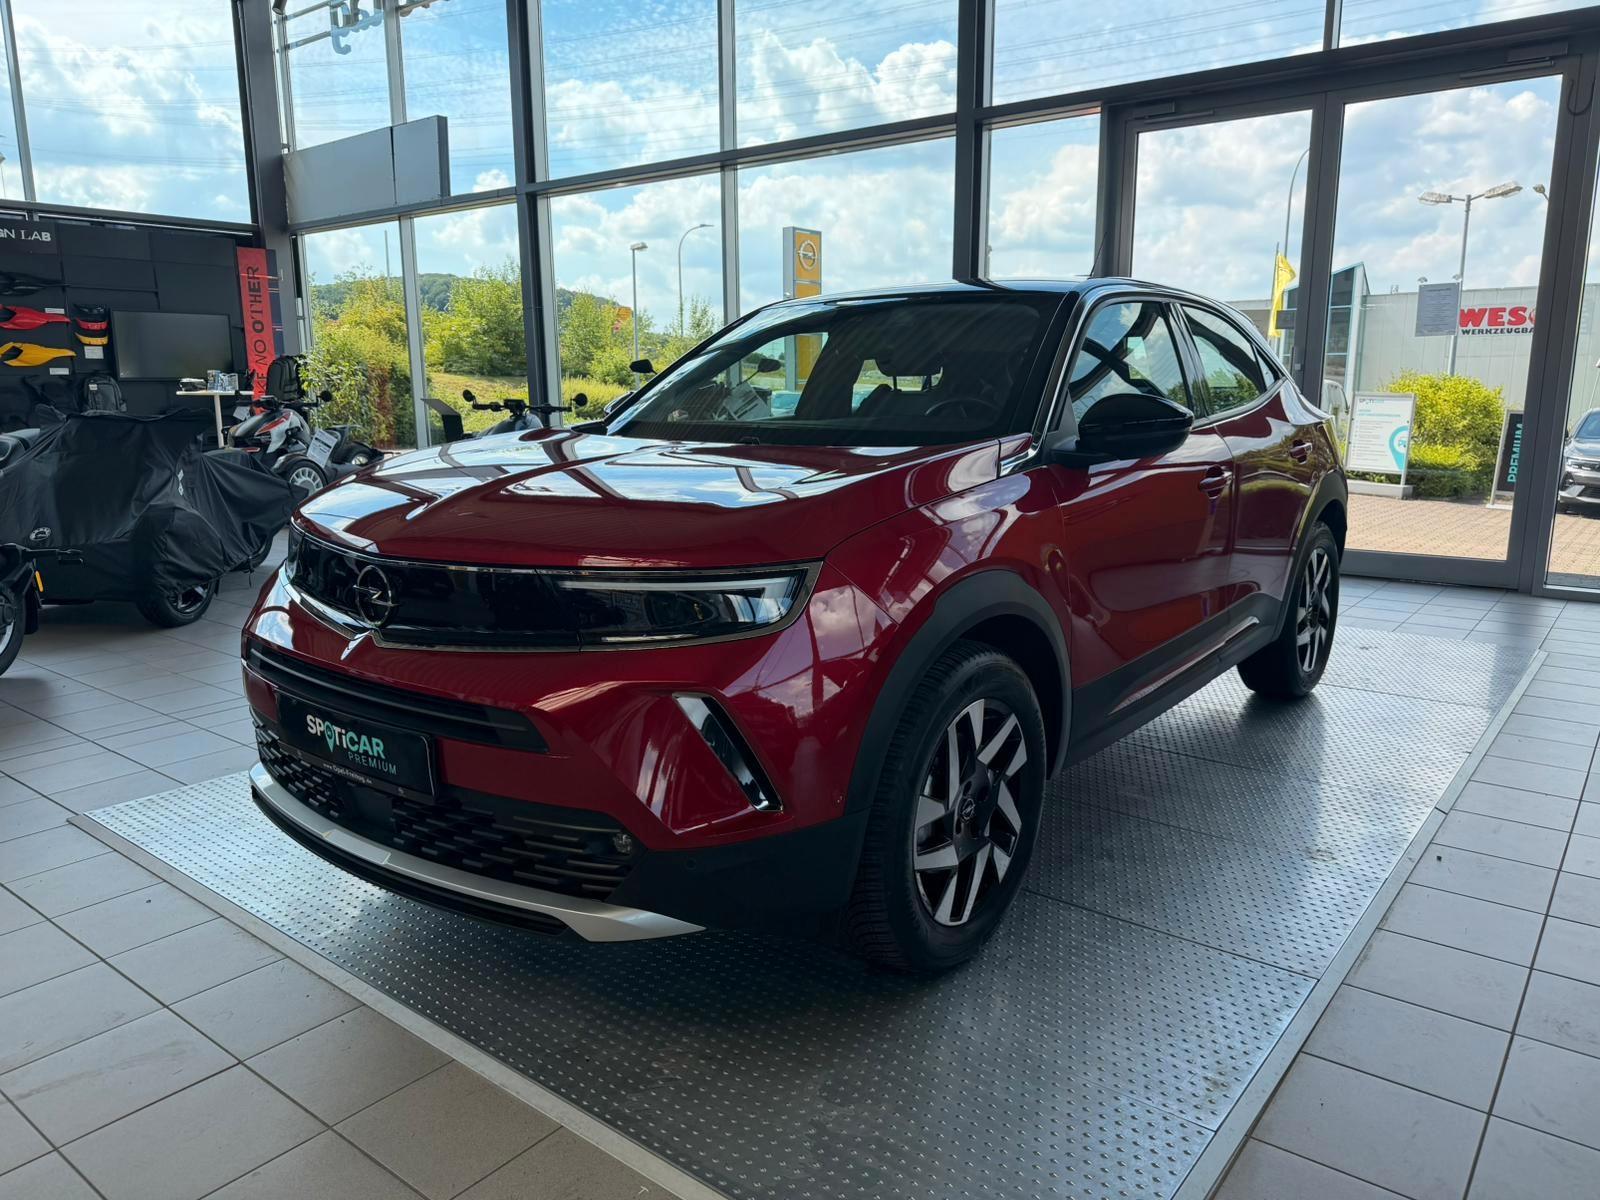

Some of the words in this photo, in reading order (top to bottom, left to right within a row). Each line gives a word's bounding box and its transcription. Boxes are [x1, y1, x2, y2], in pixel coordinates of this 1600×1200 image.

[20, 229, 52, 242] LAB
[246, 265, 265, 334] OTHER
[253, 339, 268, 366] NO
[348, 752, 396, 775] PREMIUM
